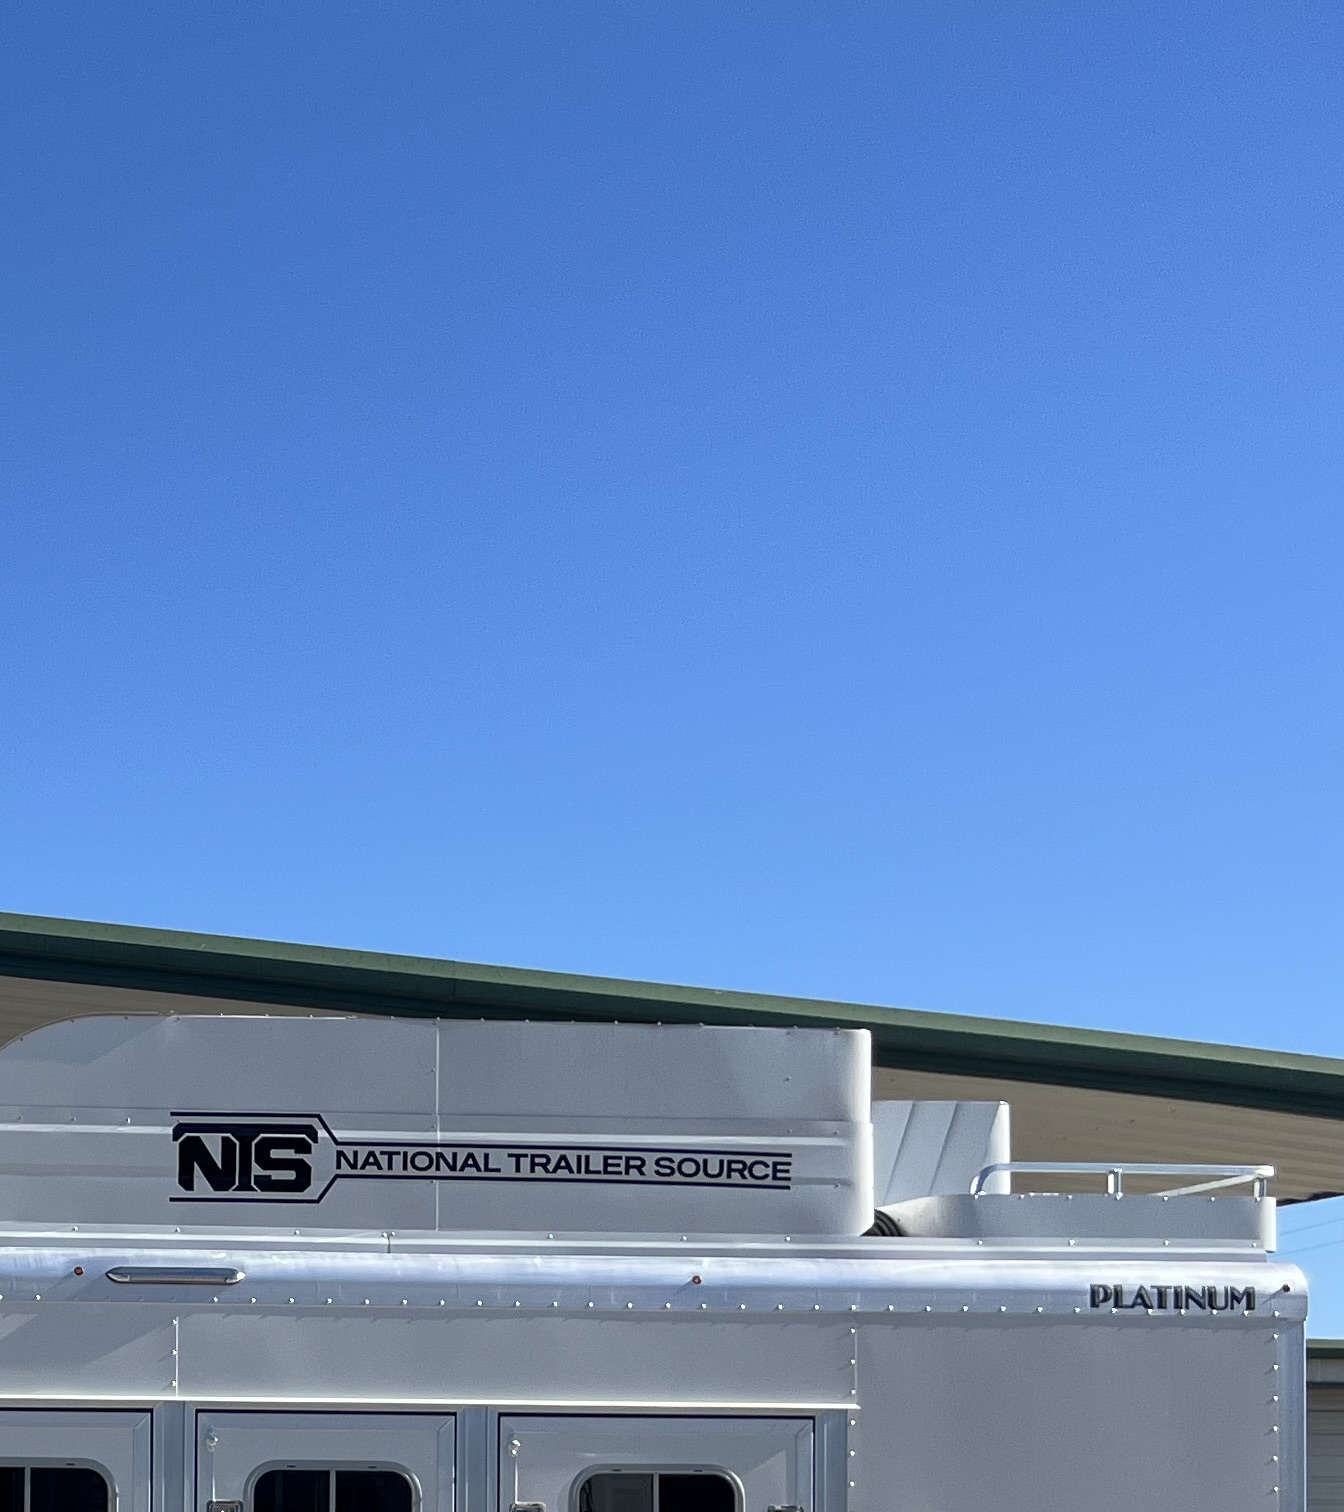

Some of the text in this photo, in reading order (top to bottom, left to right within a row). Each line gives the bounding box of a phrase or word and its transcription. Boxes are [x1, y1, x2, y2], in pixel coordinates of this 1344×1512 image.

[172, 1122, 792, 1193] NTS NATIONAL TRAILER SOURCE
[1089, 1283, 1256, 1311] PLATINUM
